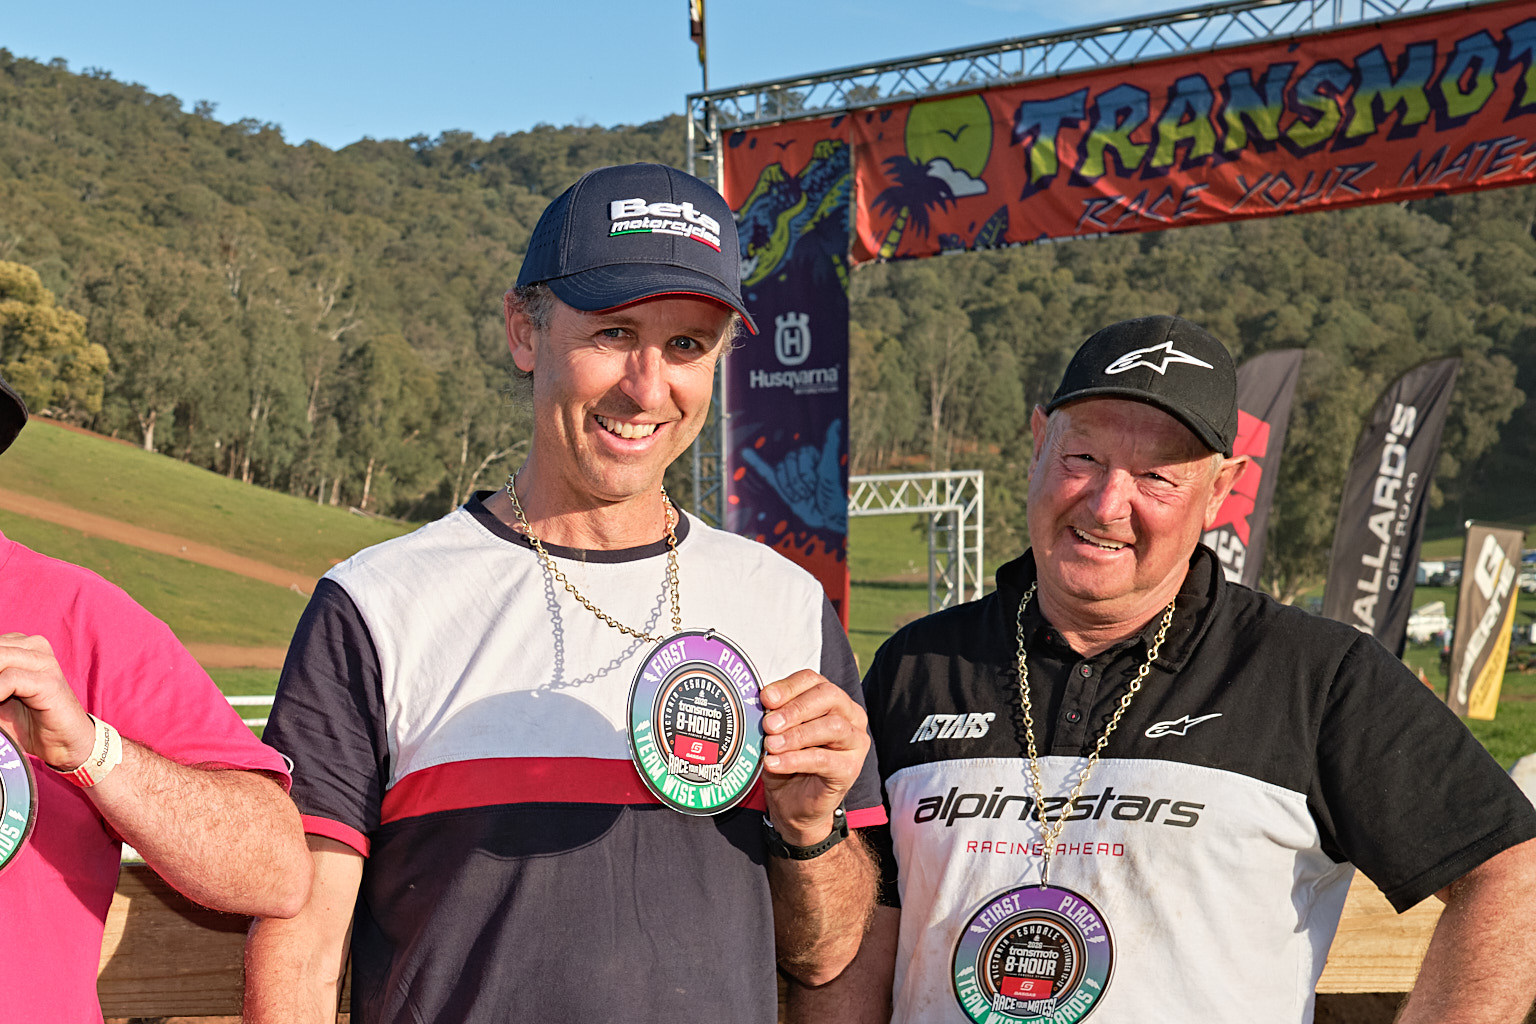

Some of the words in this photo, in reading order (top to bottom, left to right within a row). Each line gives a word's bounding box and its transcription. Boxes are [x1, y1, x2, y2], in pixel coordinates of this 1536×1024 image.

[1074, 184, 1209, 231] RACE
[1231, 161, 1377, 213] YOUR
[610, 198, 721, 235] Beta
[611, 217, 721, 247] motorcycles
[749, 367, 838, 388] Husqvarna
[1352, 402, 1417, 636] ALLARD'S
[1386, 543, 1401, 592] OFF
[1396, 472, 1418, 537] ROAD
[651, 640, 687, 678] FIRST
[717, 648, 755, 696] PLACE
[676, 711, 721, 739] 8-HOUR
[678, 700, 722, 720] transmoto
[637, 731, 667, 781] TEAM
[662, 778, 697, 807] WISE
[699, 757, 753, 808] WIZARDS
[667, 752, 690, 775] RACE
[914, 786, 1205, 828] alpinestars
[966, 840, 1044, 857] RACING
[1055, 842, 1124, 857] AHEAD
[979, 893, 1021, 928] FIRST
[1057, 895, 1100, 936] PLACE
[992, 939, 1010, 979] VICTORIA
[1004, 956, 1057, 976] 8-HOUR
[1009, 945, 1060, 959] transmoto
[958, 975, 989, 1019] TEAM
[991, 992, 1017, 1012] RACE
[1027, 997, 1058, 1018] MATES!
